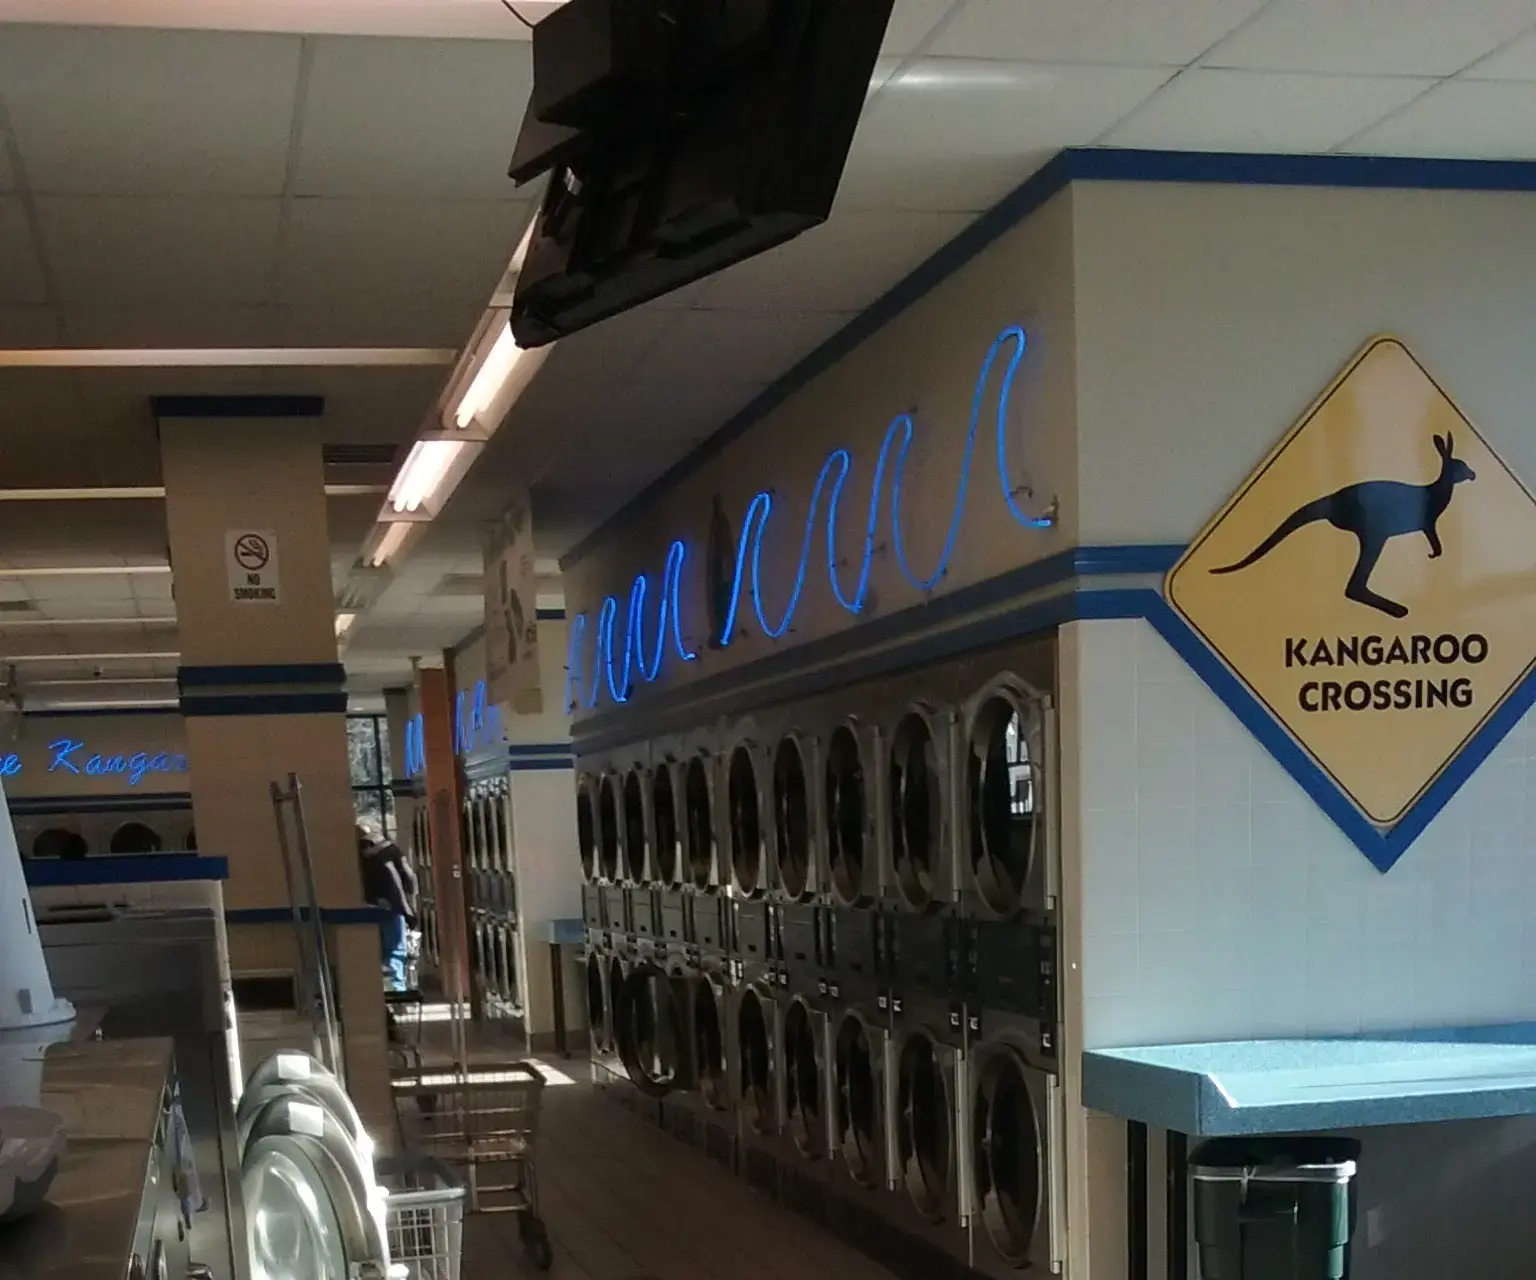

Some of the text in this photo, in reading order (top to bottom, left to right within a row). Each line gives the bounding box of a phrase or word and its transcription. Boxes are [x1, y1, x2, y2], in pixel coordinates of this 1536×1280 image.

[247, 573, 260, 586] NO
[234, 587, 276, 600] SMOKING
[1285, 633, 1489, 668] KANGAROO
[1299, 678, 1474, 713] CROSSING
[0, 754, 22, 775] e
